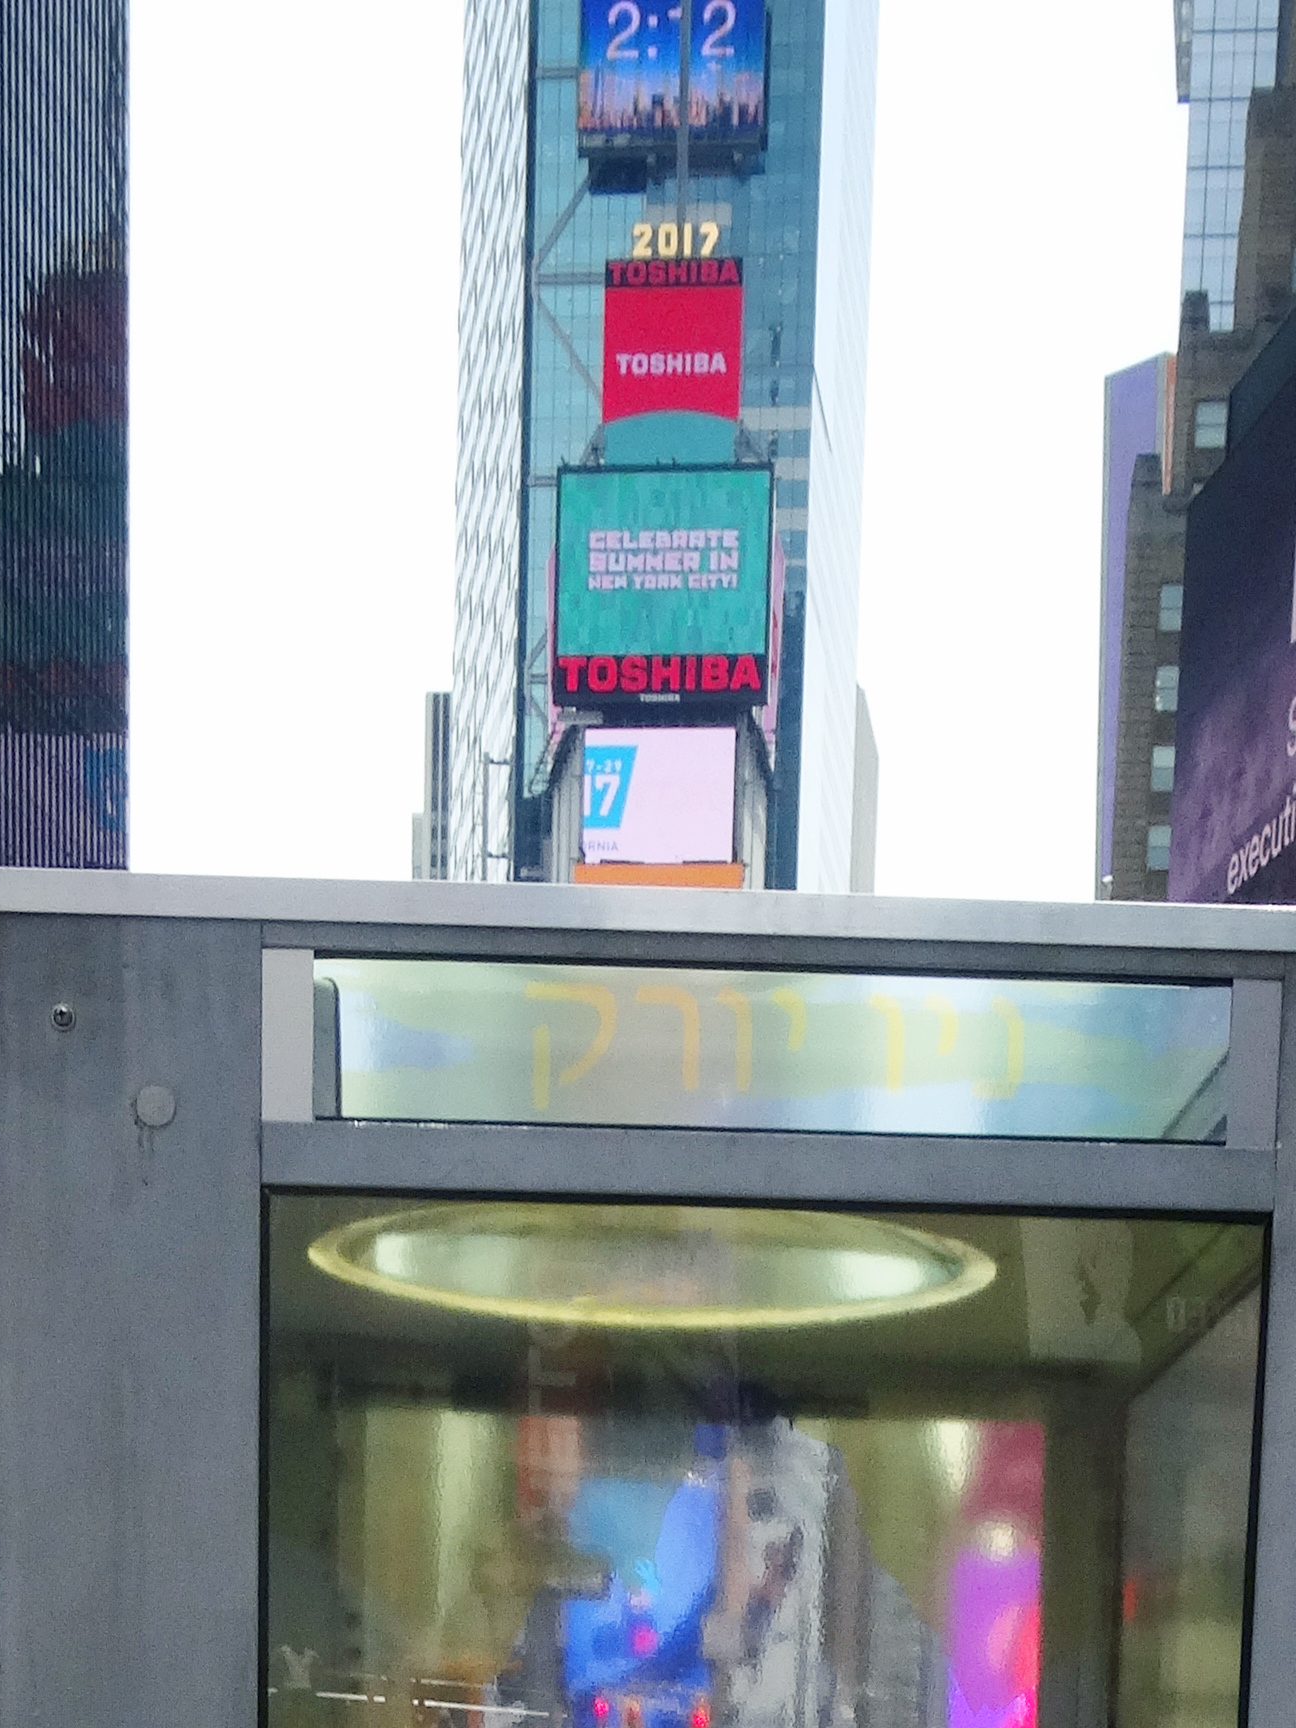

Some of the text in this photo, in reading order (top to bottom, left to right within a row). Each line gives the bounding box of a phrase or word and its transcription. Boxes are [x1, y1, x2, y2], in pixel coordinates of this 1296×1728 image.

[632, 220, 719, 257] 2017
[608, 260, 740, 285] TOSHIBA
[615, 352, 727, 375] TOSHIBA
[589, 529, 739, 549] CELEBRATE
[589, 549, 739, 572] SUMMER IN
[588, 573, 738, 591] NEW YORK CITY!
[558, 654, 761, 693] TOSHIBA
